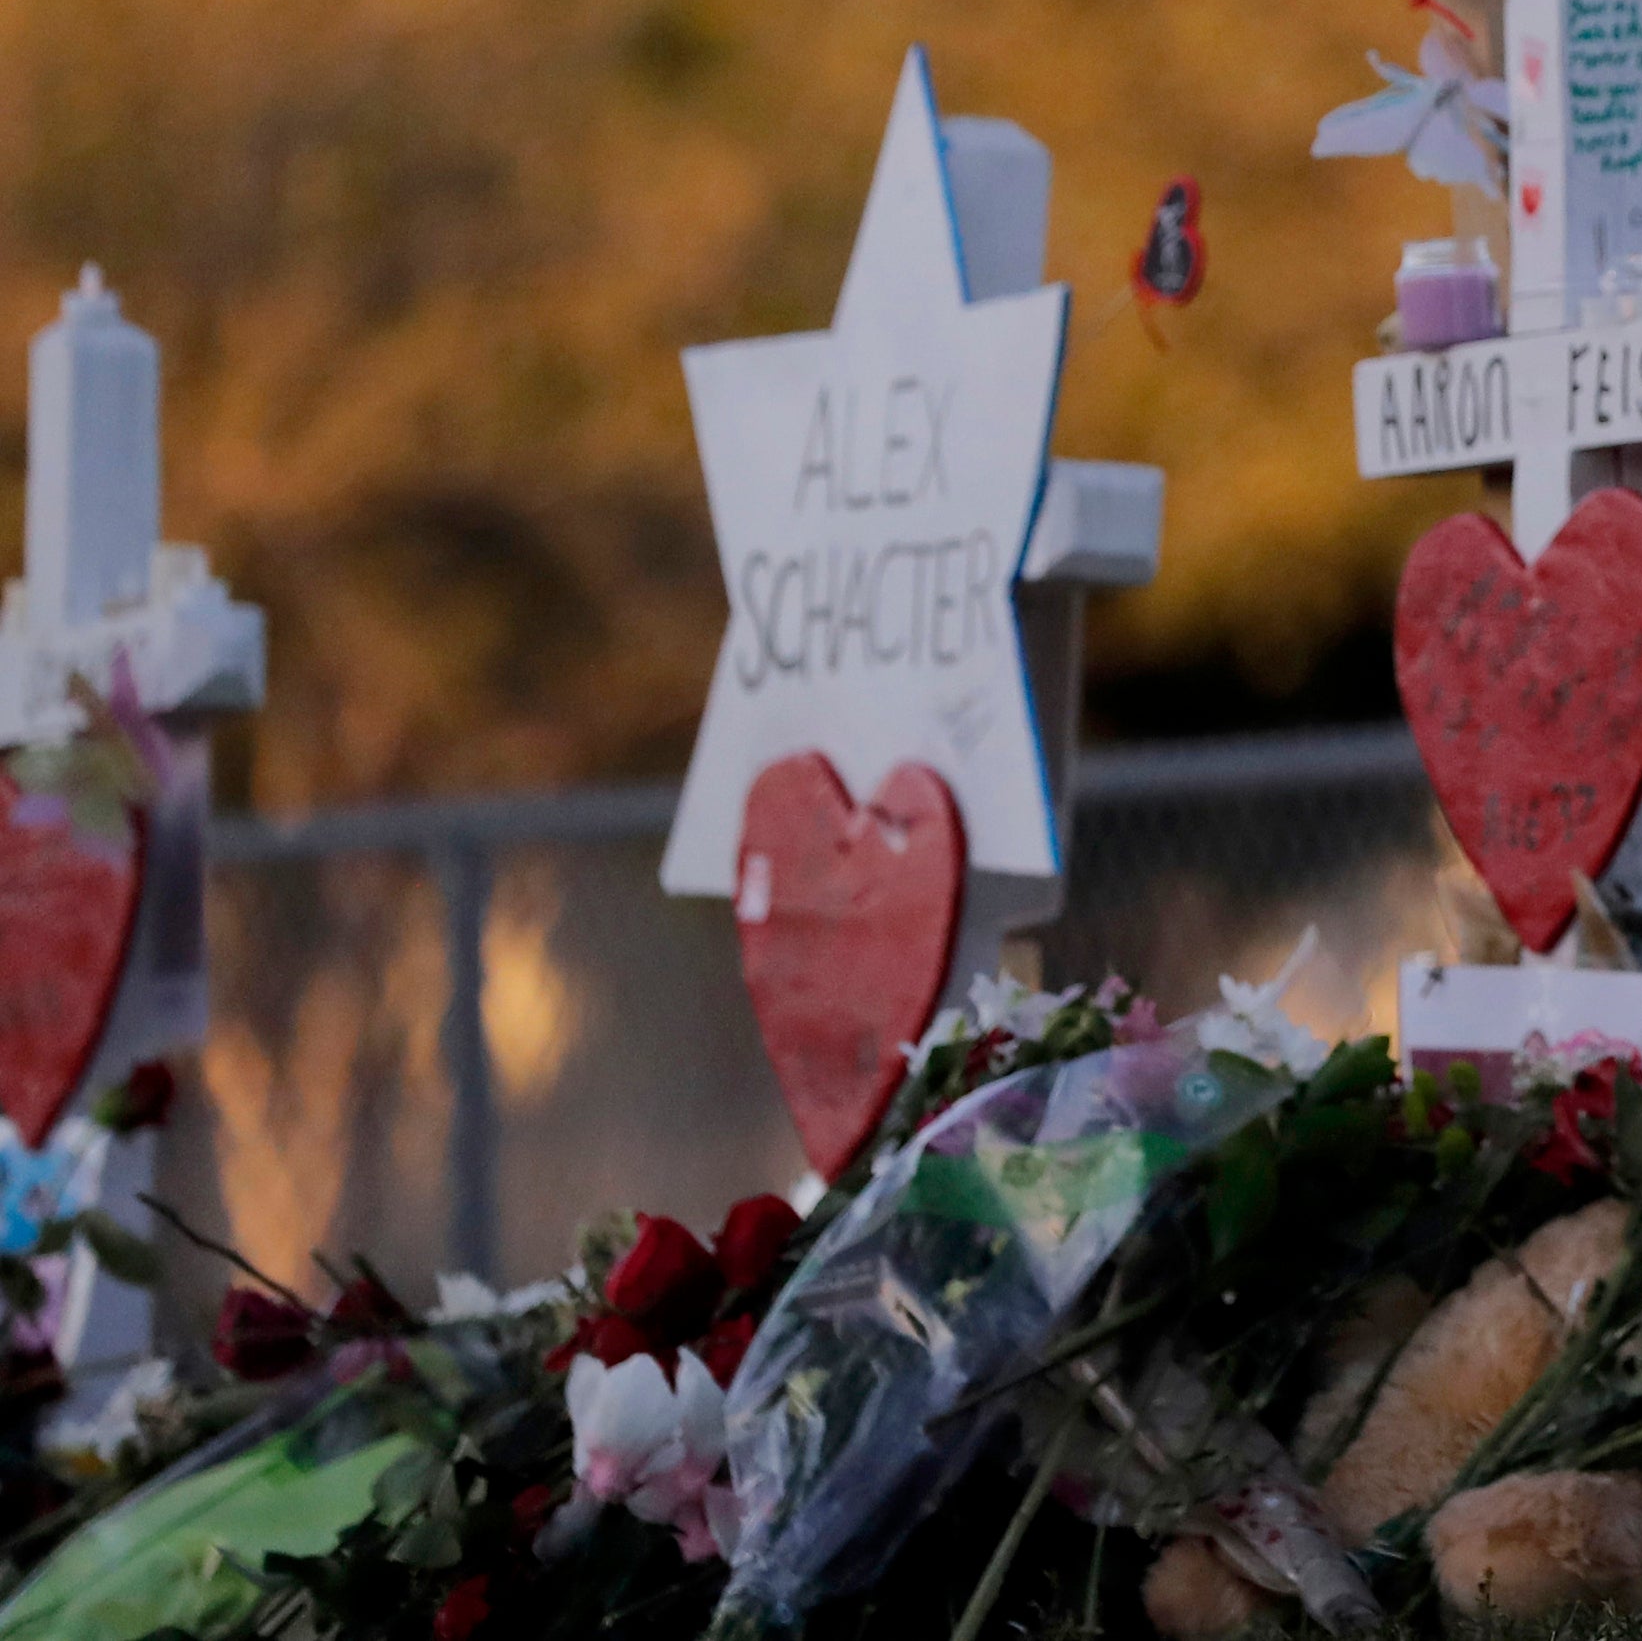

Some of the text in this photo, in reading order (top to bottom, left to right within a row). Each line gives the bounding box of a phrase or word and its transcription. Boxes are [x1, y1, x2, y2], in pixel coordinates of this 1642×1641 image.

[794, 375, 957, 513] ALEX
[1379, 353, 1512, 464] AARON
[735, 525, 996, 695] SCHACTER
